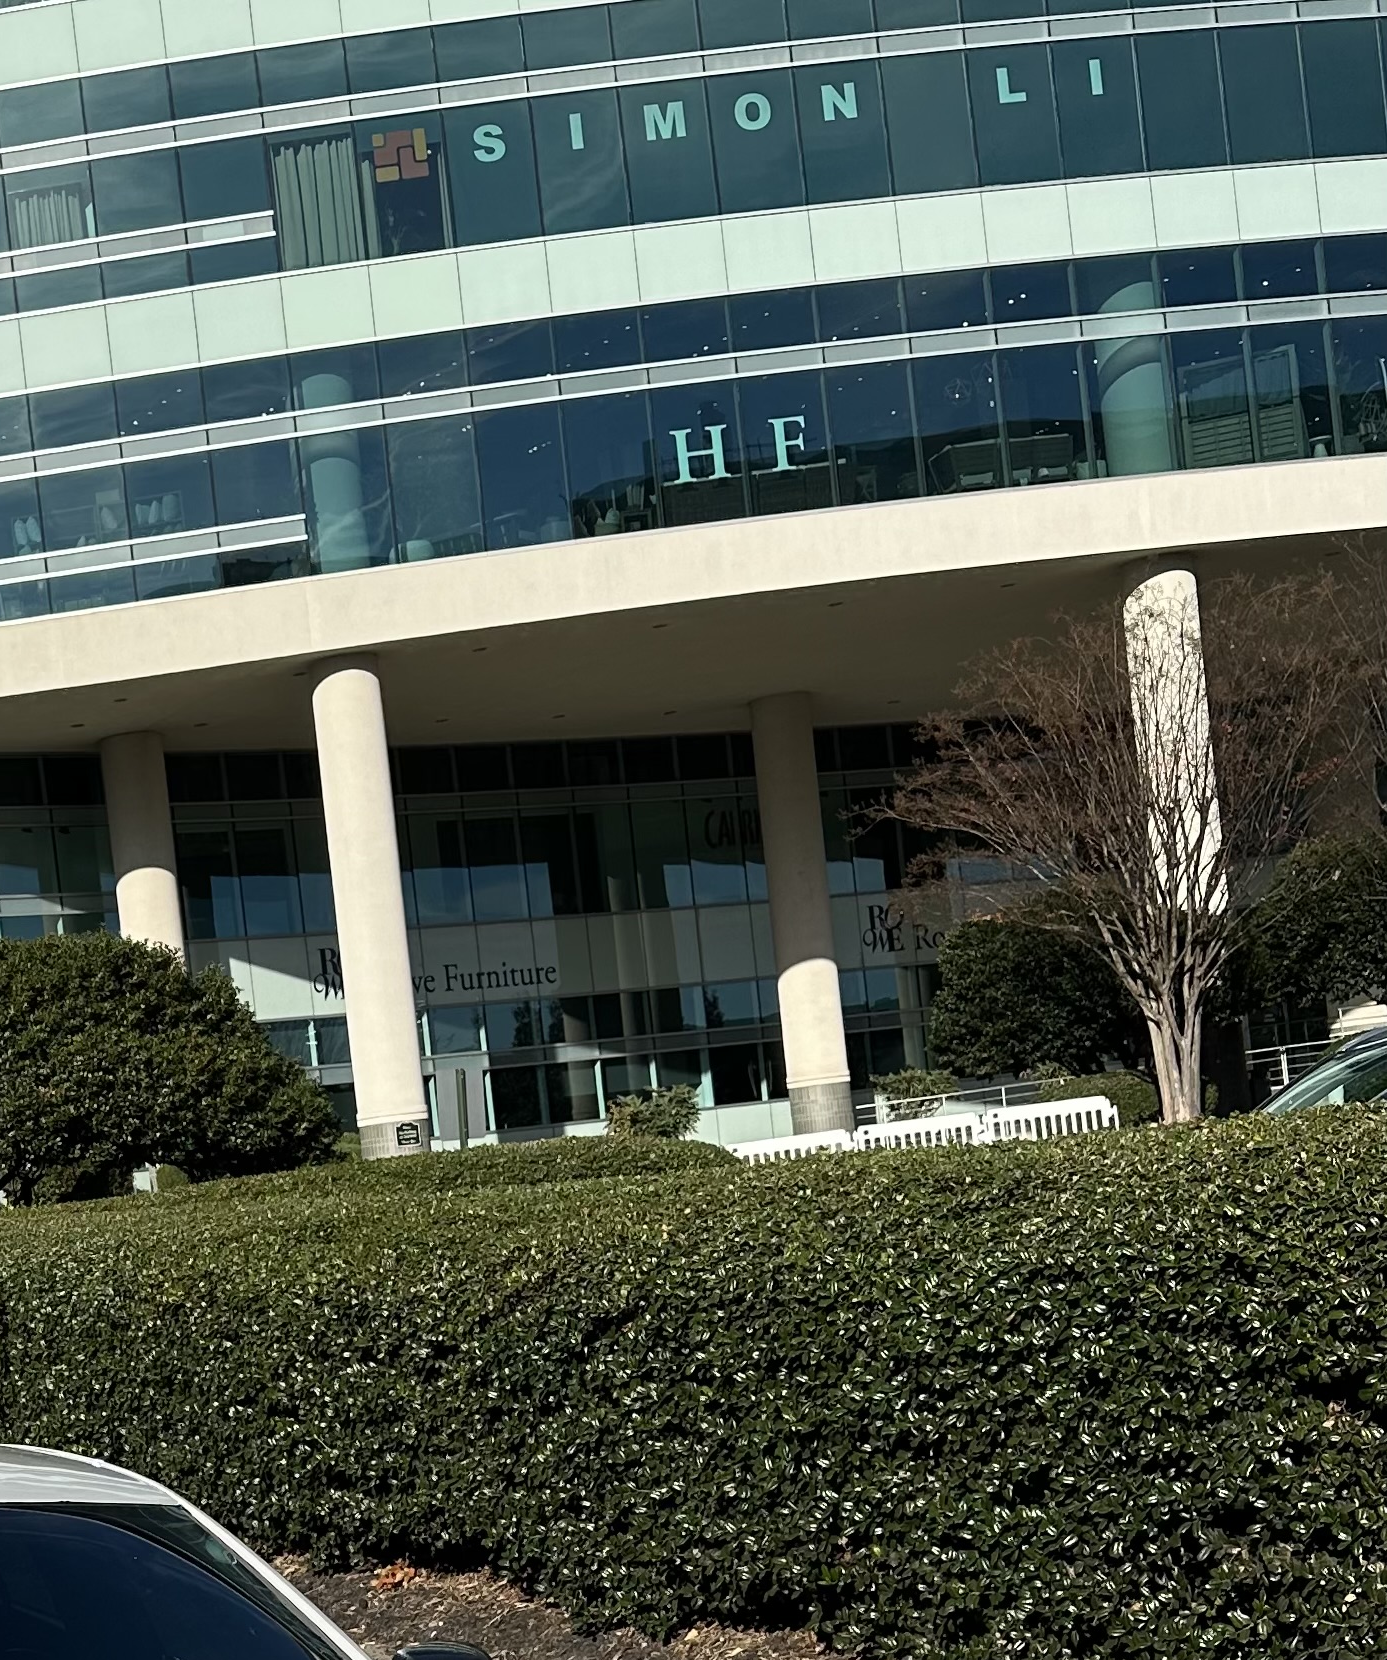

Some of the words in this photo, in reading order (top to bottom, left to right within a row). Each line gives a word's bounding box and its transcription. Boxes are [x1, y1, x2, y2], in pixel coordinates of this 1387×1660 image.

[473, 81, 859, 163] SIMON
[995, 58, 1105, 104] LI
[442, 962, 557, 993] Furniture
